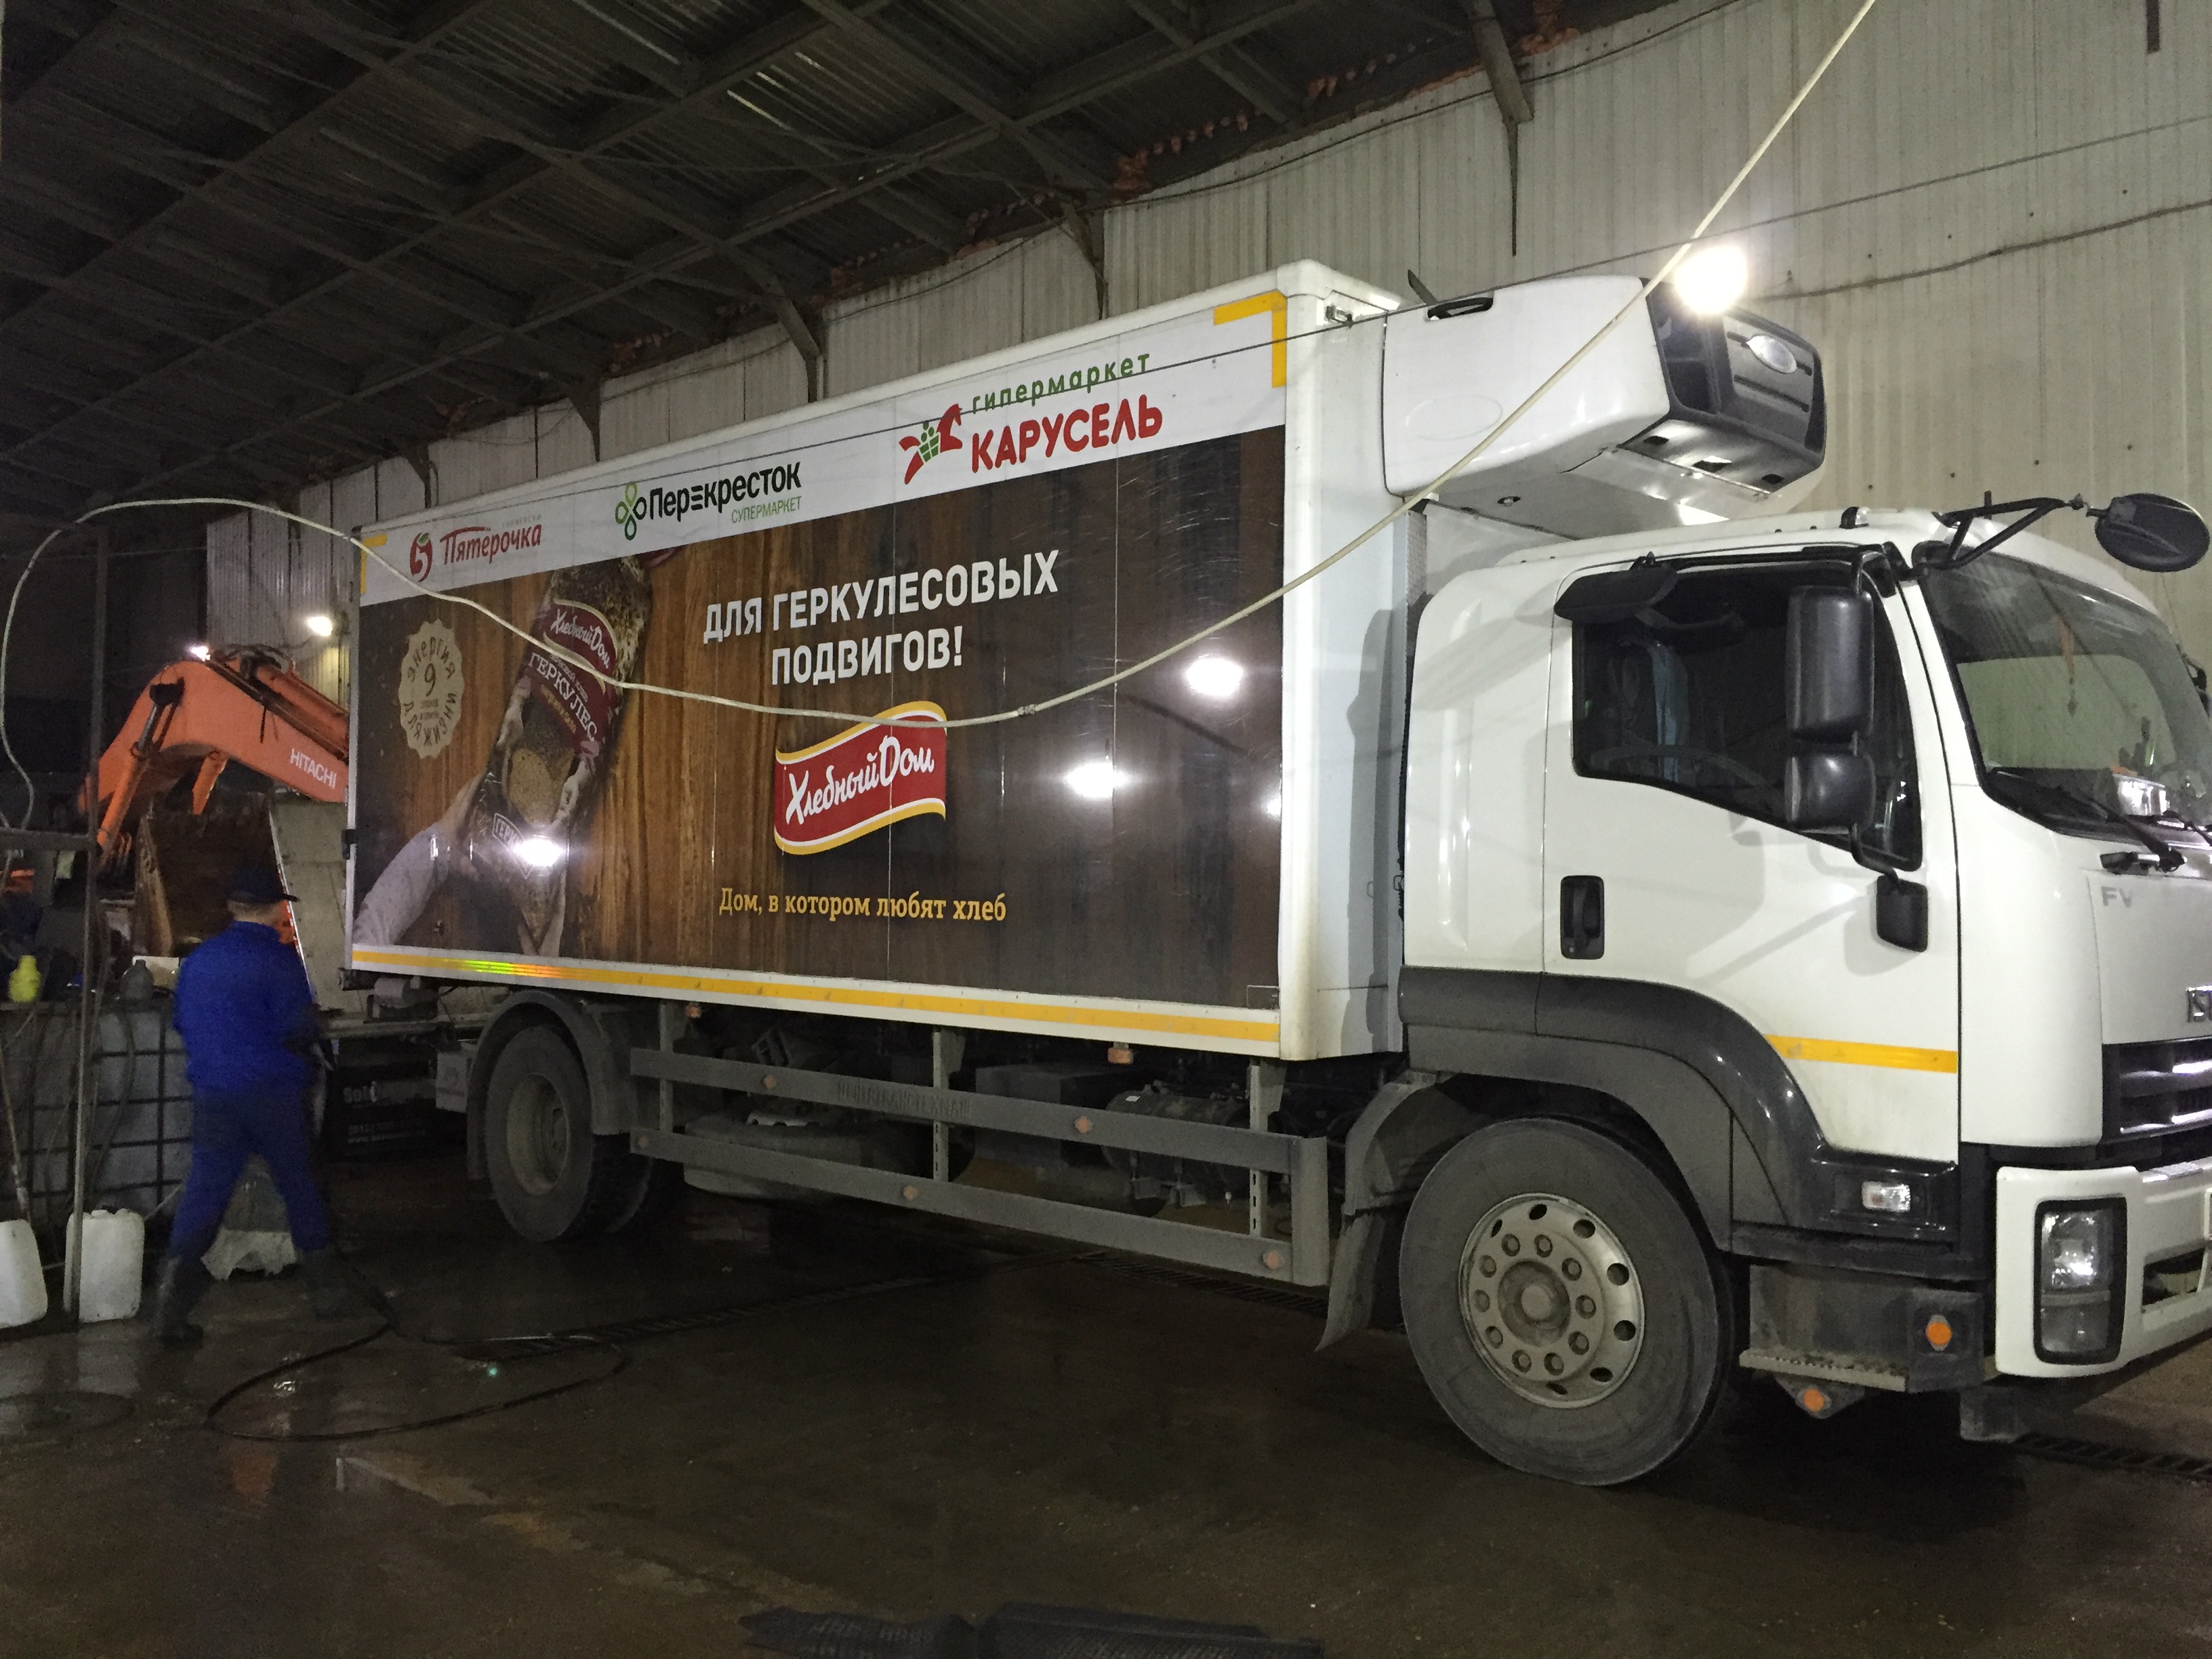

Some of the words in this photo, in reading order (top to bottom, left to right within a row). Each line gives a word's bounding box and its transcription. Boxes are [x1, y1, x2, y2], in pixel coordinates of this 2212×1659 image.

[972, 352, 1150, 414] гипермаркет
[971, 394, 1163, 473] КАРУСЕЛЬ
[731, 495, 802, 523] СУПЕРМАРКЕТ
[703, 596, 762, 644] ДЛЯ
[772, 550, 1059, 631] ГЕРКУЛЕСОВЫХ
[424, 662, 436, 697] 9
[771, 626, 964, 685] ПОДВИГОВ!
[528, 652, 598, 742] ГЕРКУЛЕС
[290, 748, 337, 790] HITACHI
[719, 887, 762, 916] Дом,
[768, 894, 779, 913] в
[785, 894, 870, 922] котором
[876, 890, 947, 920] любят
[952, 893, 1007, 921] хлеб
